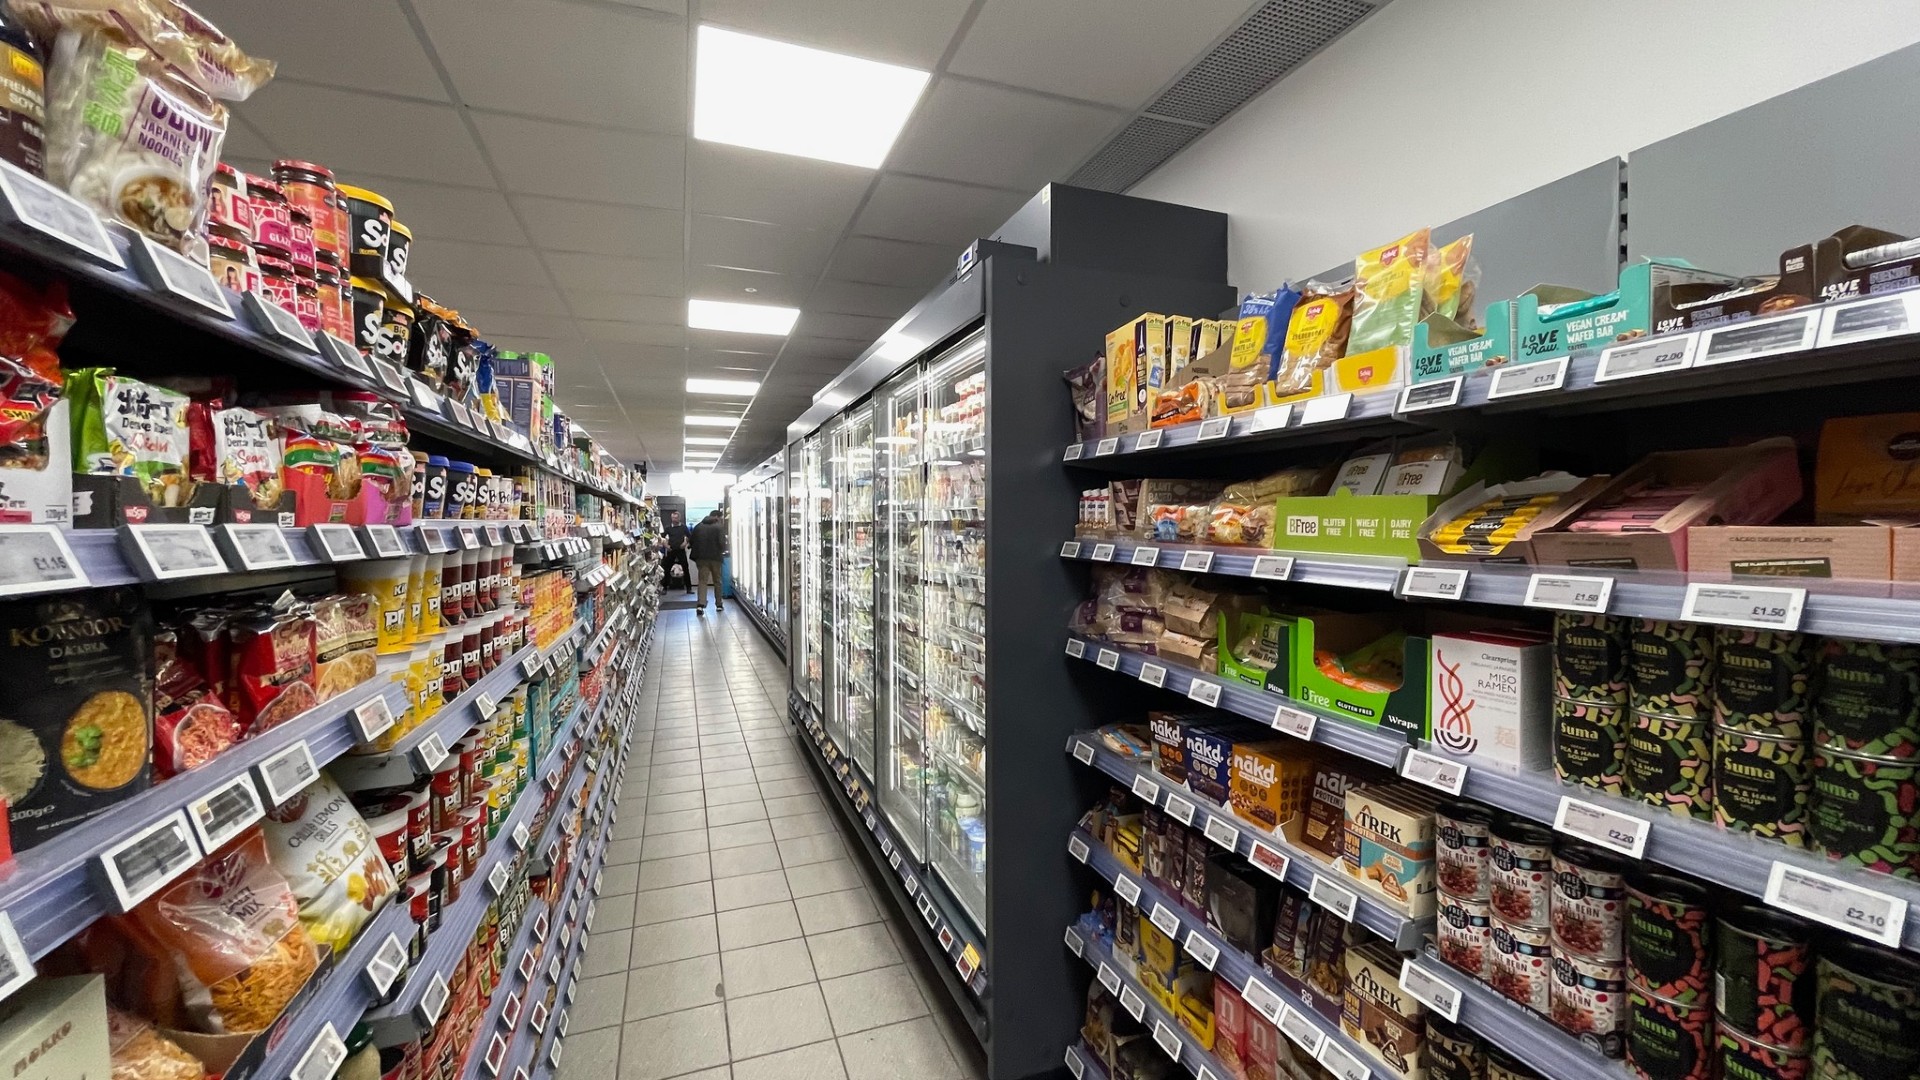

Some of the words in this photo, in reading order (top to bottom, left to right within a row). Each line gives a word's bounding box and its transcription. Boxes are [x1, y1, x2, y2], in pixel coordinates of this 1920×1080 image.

[138, 132, 183, 168] NOODLES
[1869, 265, 1914, 285] PEANUT
[1820, 278, 1861, 297] LOVE
[1826, 290, 1860, 303] Raw
[1566, 317, 1593, 333] VEGAN
[1657, 316, 1685, 331] LOVE
[1521, 329, 1560, 349] LOVE
[1566, 330, 1594, 344] WAFER
[1596, 325, 1614, 338] BAR
[1448, 344, 1467, 358] VEGAN
[1526, 342, 1558, 356] Raw
[1655, 351, 1684, 363] £2.00
[1415, 353, 1443, 370] LOVE
[1448, 355, 1469, 368] WAFER
[1470, 352, 1483, 364] BAR
[1419, 365, 1442, 377] Raw
[1289, 518, 1317, 534] BFree
[1322, 518, 1346, 527] GLUTEN
[1356, 518, 1379, 528] WHEAT
[1390, 519, 1412, 529] DAIRY
[1326, 527, 1342, 536] FREE
[1359, 528, 1376, 538] FREE
[1391, 529, 1410, 539] FREE
[1575, 593, 1599, 602] £1.50
[1752, 606, 1786, 618] £1.50
[1565, 633, 1607, 648] Suma
[1481, 652, 1518, 666] Clearspring
[1722, 652, 1773, 669] Suma
[1489, 672, 1517, 685] MISO
[1478, 680, 1517, 694] RAMEN
[1302, 686, 1330, 708] BFree
[1337, 701, 1358, 712] GLUTEN
[1358, 706, 1373, 717] FREE
[1388, 714, 1419, 731] Wraps
[1561, 721, 1599, 740] Suma
[1724, 756, 1775, 780] Suma
[1315, 771, 1364, 794] nāk
[314, 794, 347, 828] LEMON
[1359, 811, 1402, 844] TREK
[1608, 829, 1635, 844] £2.20
[1506, 873, 1528, 888] BEAN
[235, 898, 265, 922] MIX
[1575, 903, 1600, 919] BEAN
[1846, 906, 1886, 928] £2.10
[1631, 912, 1673, 940] Suma
[1459, 930, 1480, 944] BEAN
[1509, 957, 1528, 973] BEAN
[1358, 974, 1403, 1013] TREK
[1567, 990, 1592, 1007] BEAN
[1634, 1009, 1677, 1040] Suma
